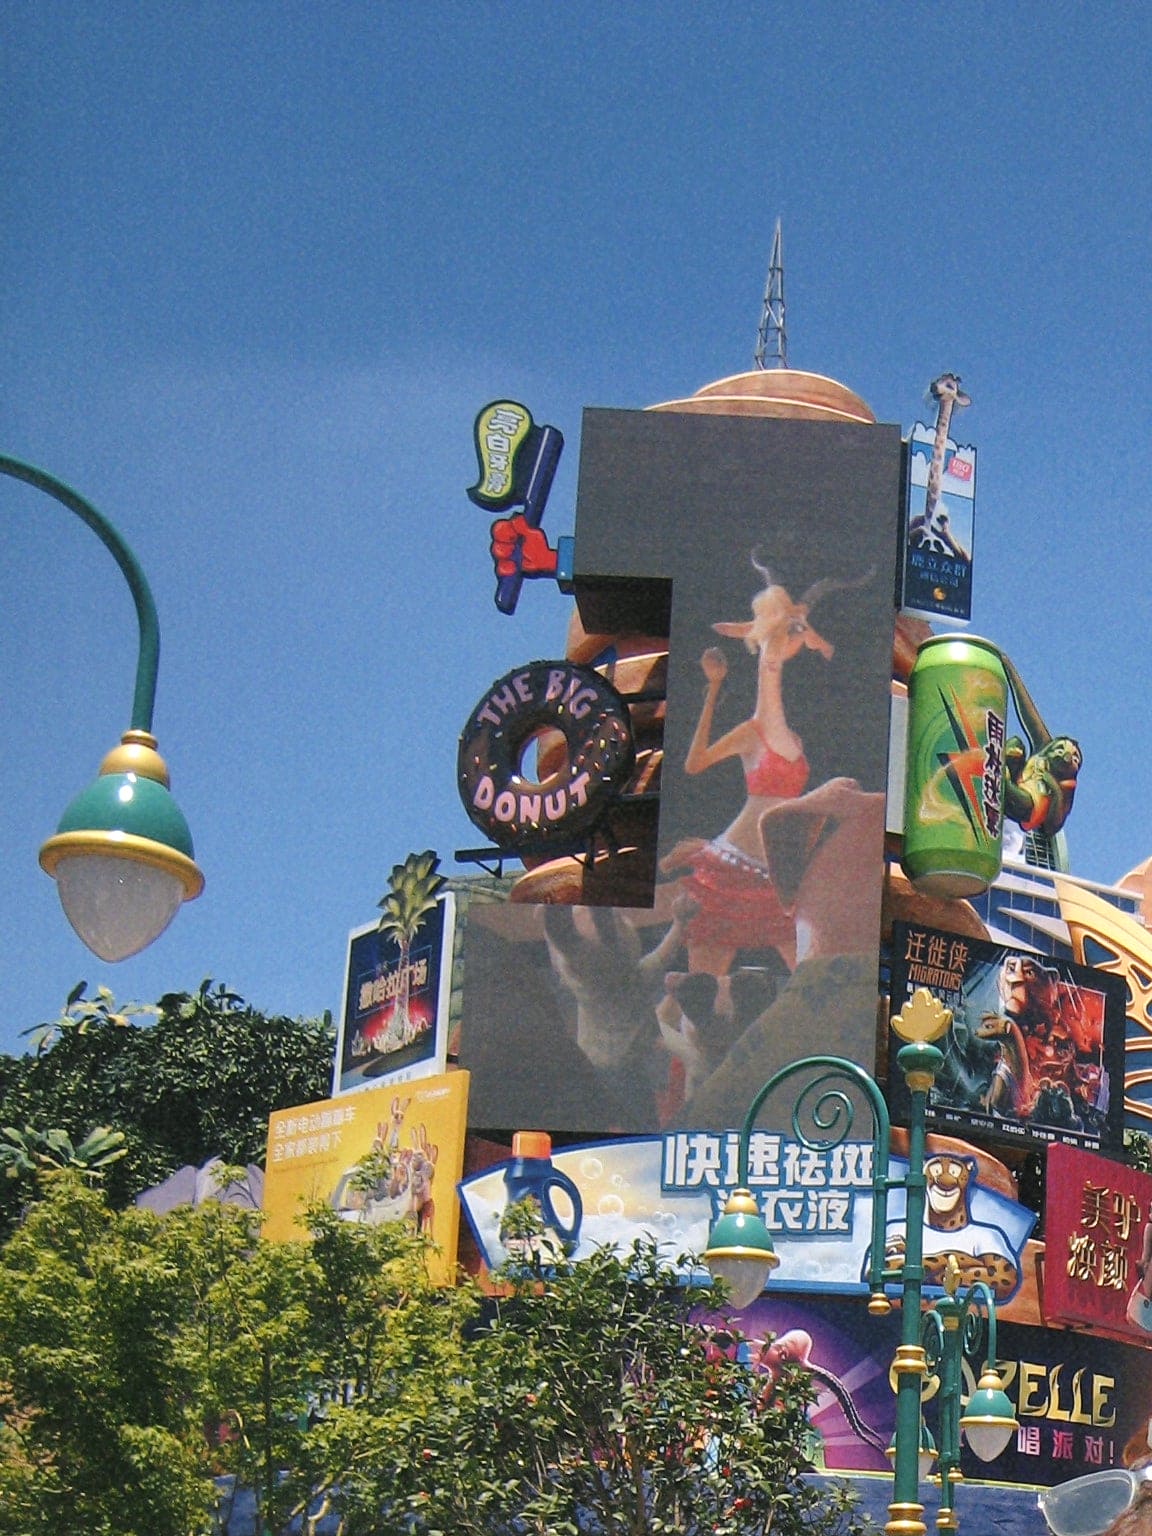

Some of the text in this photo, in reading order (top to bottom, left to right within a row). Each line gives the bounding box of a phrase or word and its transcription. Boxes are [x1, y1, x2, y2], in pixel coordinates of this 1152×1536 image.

[477, 669, 599, 726] THE BIG
[473, 772, 591, 824] DONUT
[905, 929, 969, 973] 迁徙侠
[908, 963, 963, 991] MIGRATORS
[664, 1133, 873, 1187] 快速祛斑
[717, 1189, 850, 1231] 衣液
